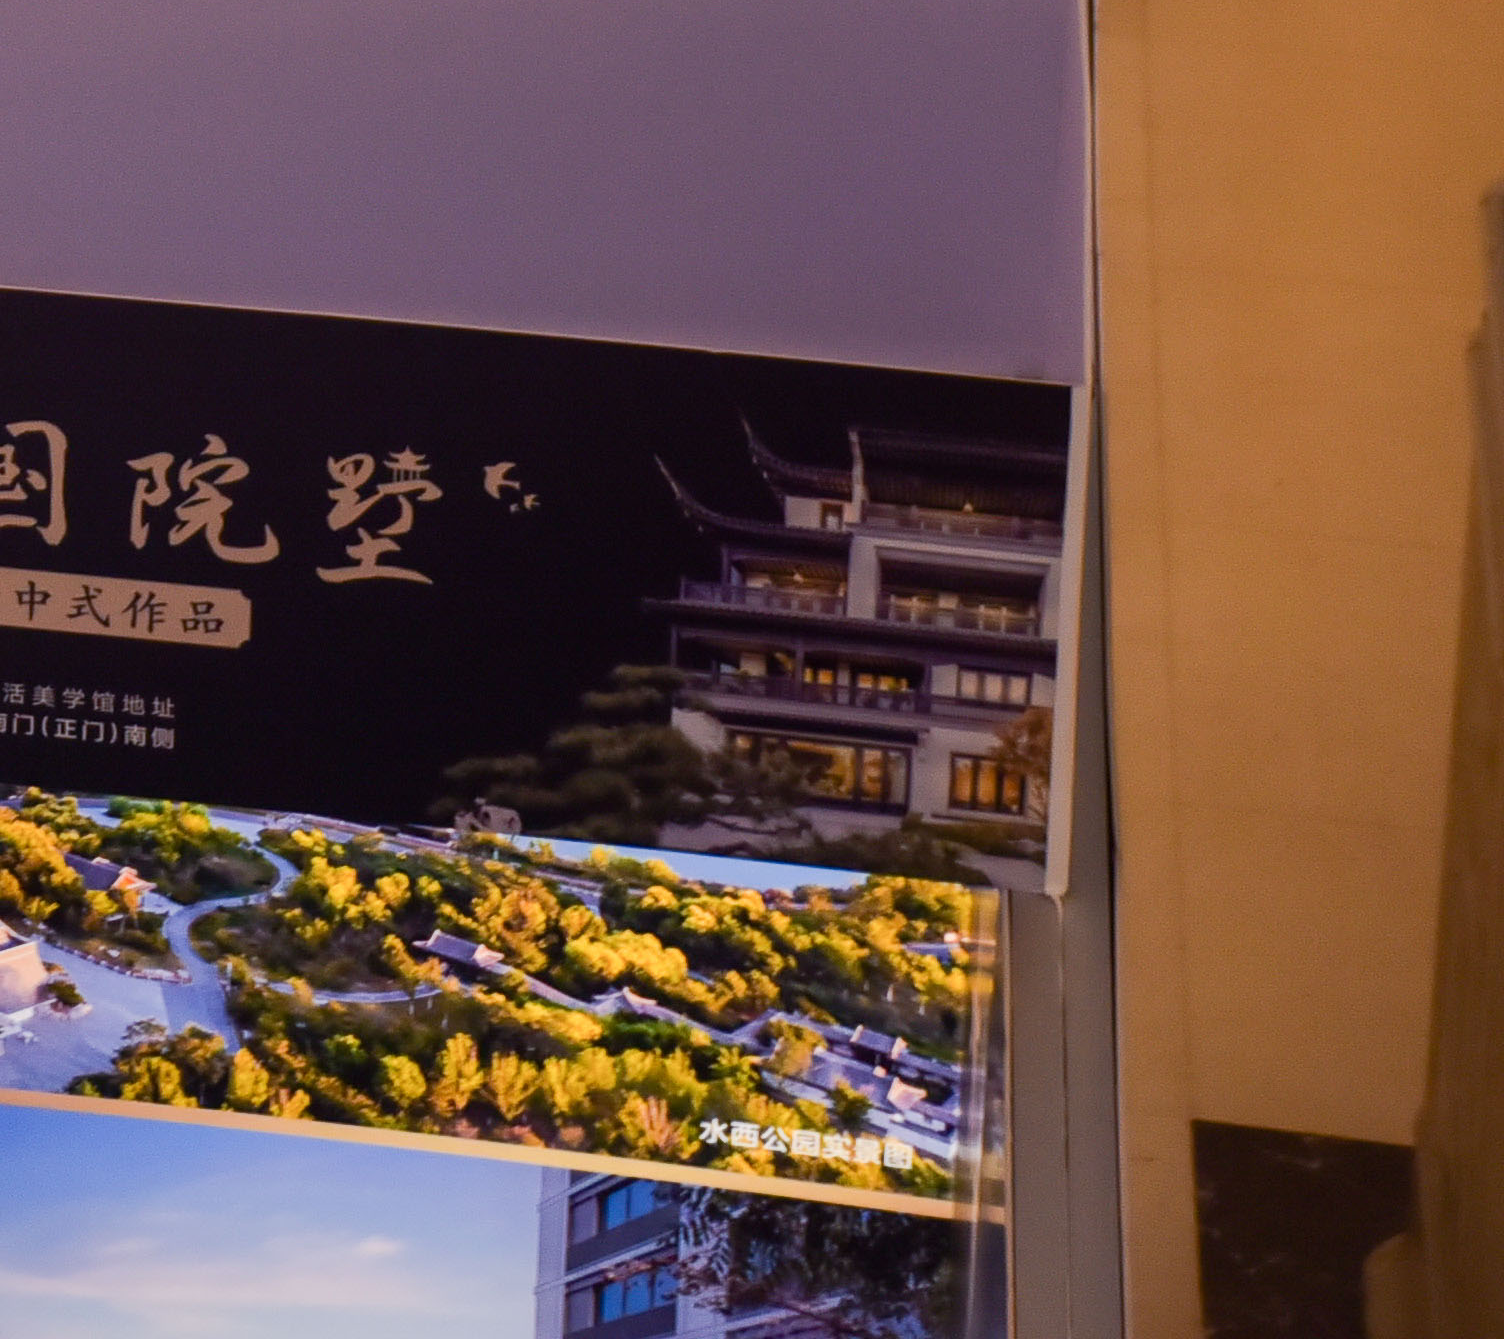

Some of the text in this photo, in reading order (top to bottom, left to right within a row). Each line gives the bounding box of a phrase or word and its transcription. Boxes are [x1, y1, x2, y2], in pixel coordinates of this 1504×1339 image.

[699, 1117, 913, 1170] 水西公园实景图
